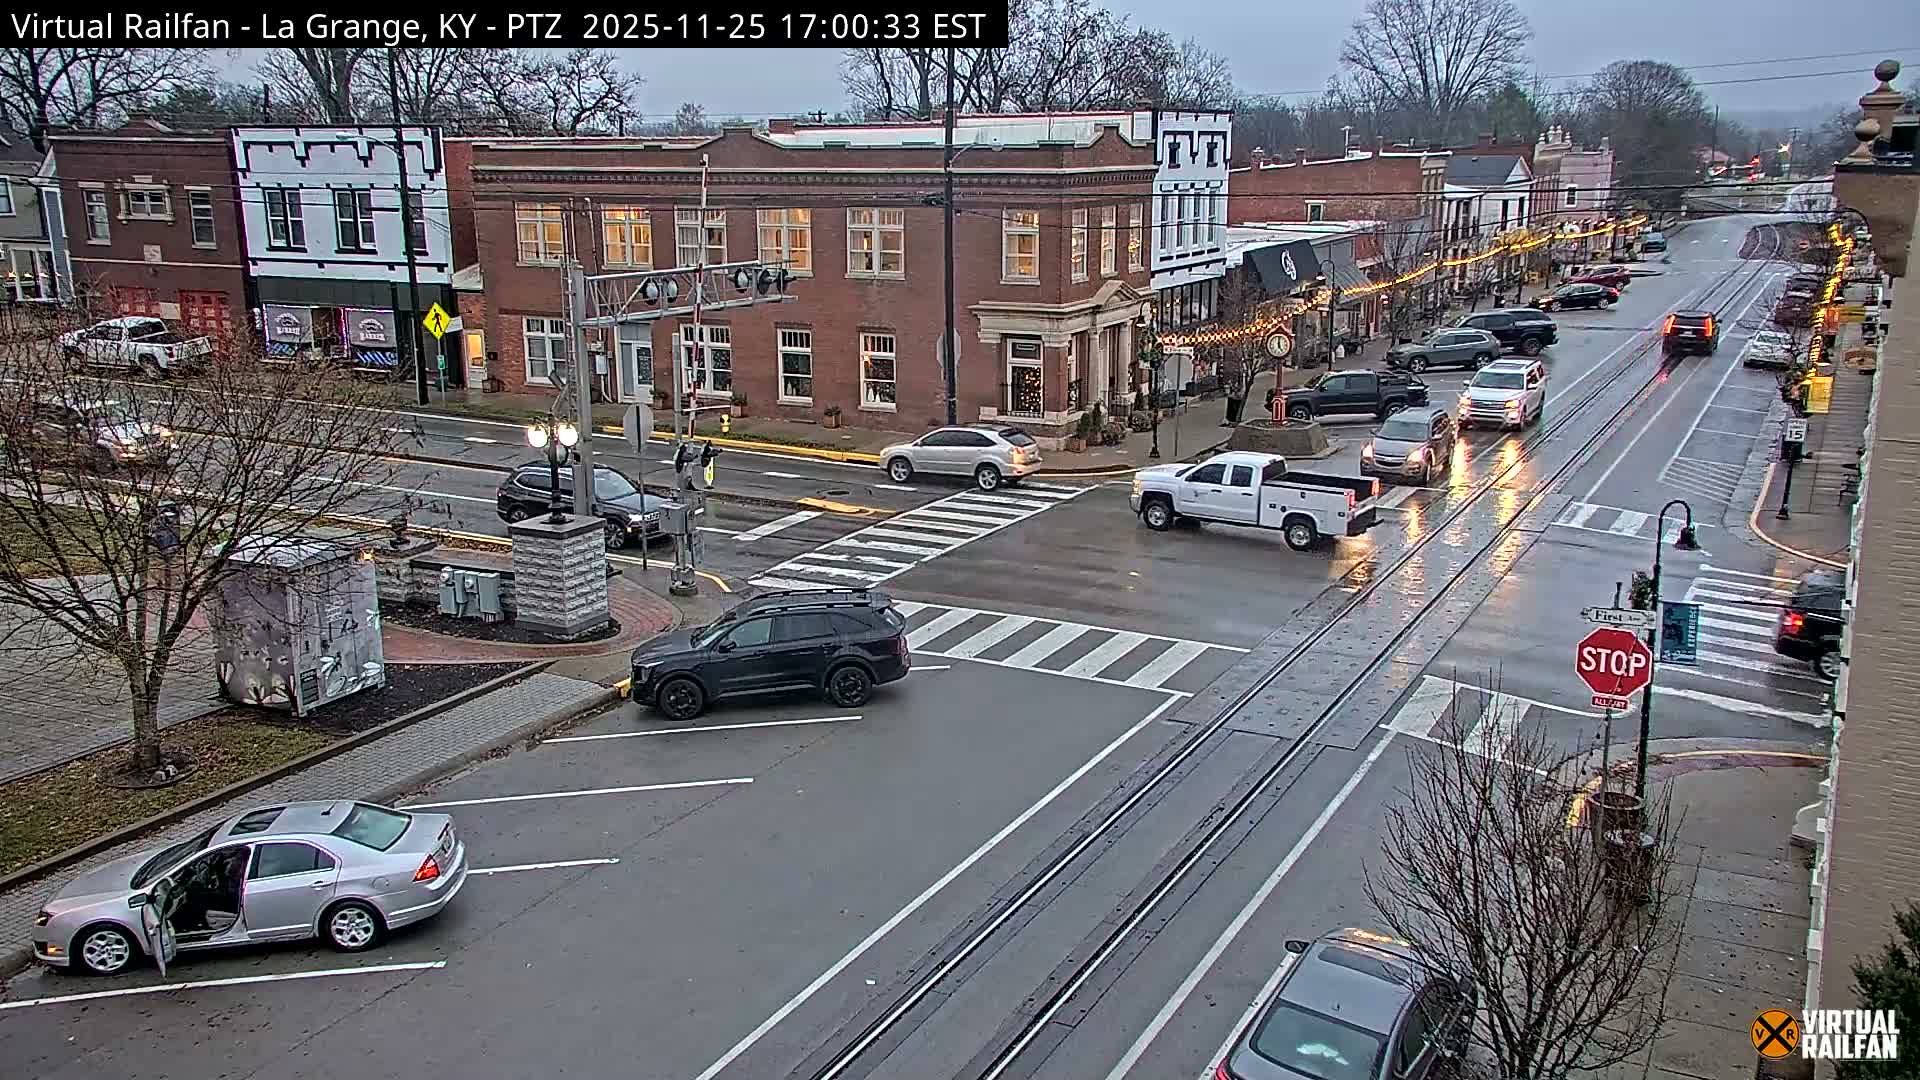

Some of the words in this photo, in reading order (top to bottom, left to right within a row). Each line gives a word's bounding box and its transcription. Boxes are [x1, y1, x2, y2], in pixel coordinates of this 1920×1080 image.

[1789, 430, 1804, 439] 15
[1595, 610, 1622, 621] First
[1580, 646, 1646, 677] STOP
